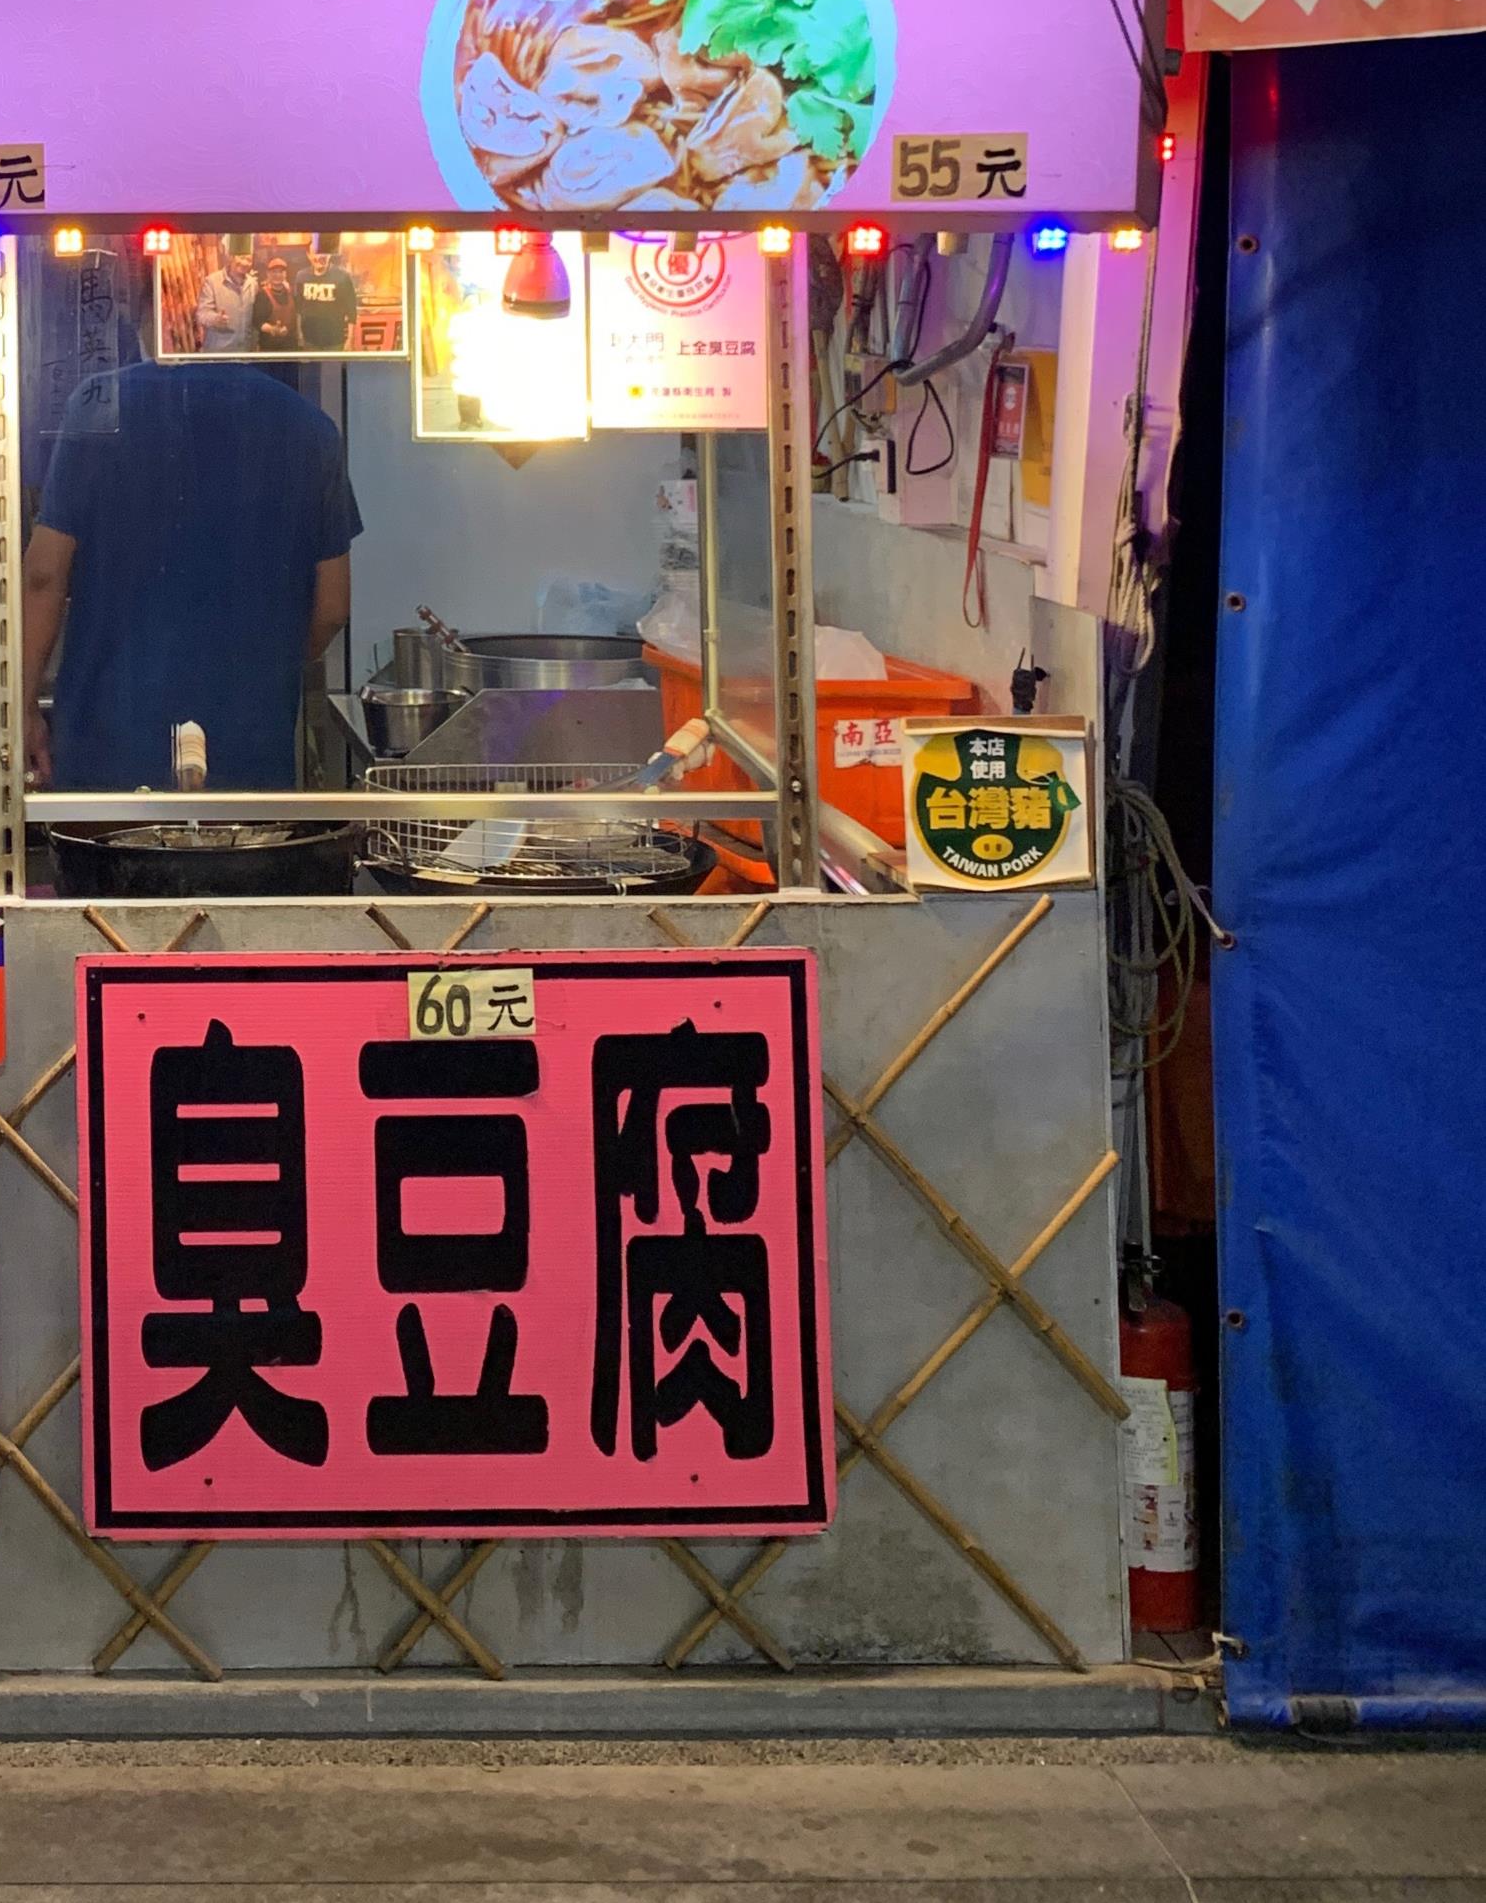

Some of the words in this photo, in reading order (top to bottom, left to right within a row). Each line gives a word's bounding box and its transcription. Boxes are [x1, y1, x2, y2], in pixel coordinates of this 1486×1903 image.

[841, 718, 896, 747] 南亞
[969, 736, 1005, 756] 本店
[969, 760, 1006, 780] 使用
[926, 786, 1052, 831] 台灣豬
[942, 846, 999, 878] TAIWAN
[1001, 846, 1044, 875] PORK
[140, 1017, 775, 1473] 臭豆腐
